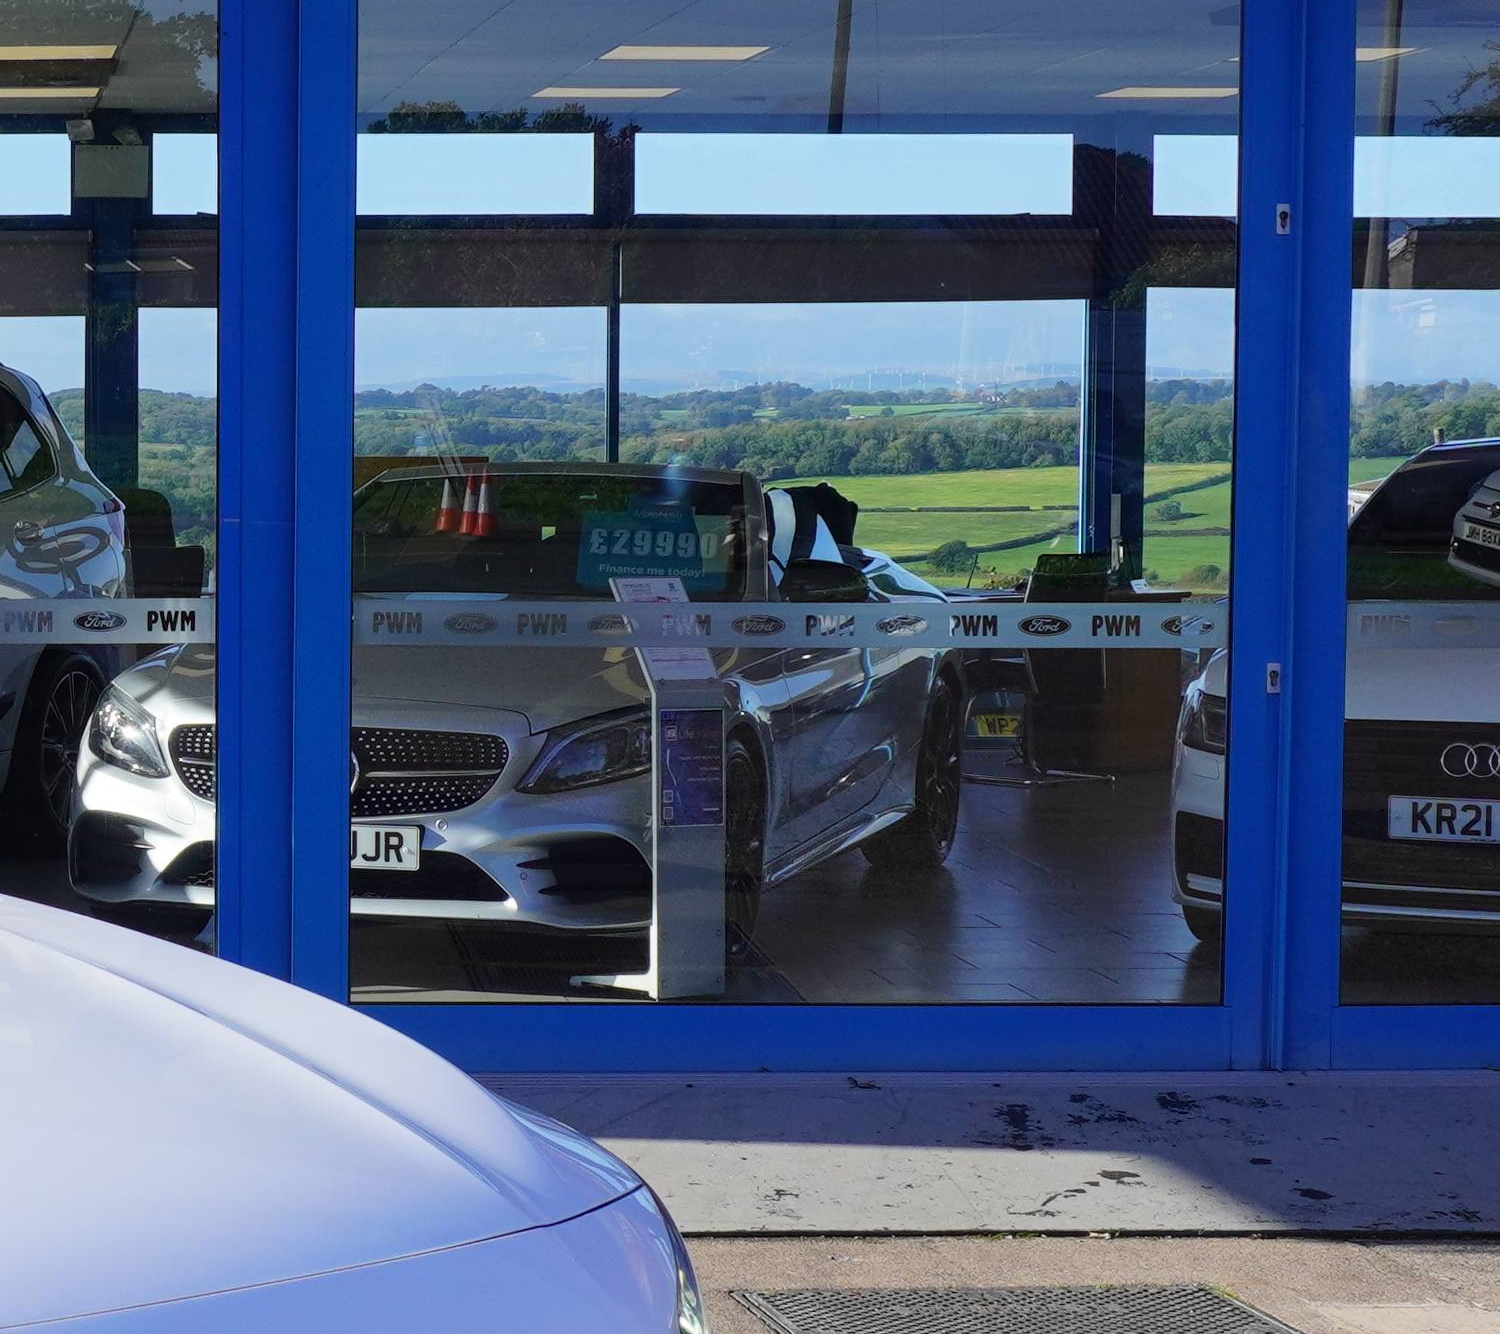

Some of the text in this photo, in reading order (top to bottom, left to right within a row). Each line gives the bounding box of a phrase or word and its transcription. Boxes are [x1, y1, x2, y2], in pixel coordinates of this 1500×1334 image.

[589, 527, 719, 559] £29990
[598, 563, 644, 576] Finance
[647, 567, 665, 576] me
[4, 610, 53, 633] PWM
[147, 610, 196, 632] PWM
[372, 612, 423, 634] PWM
[516, 613, 568, 635] PWM
[949, 614, 998, 637] PWM
[1092, 614, 1141, 637] PWM
[1411, 801, 1493, 836] KR21
